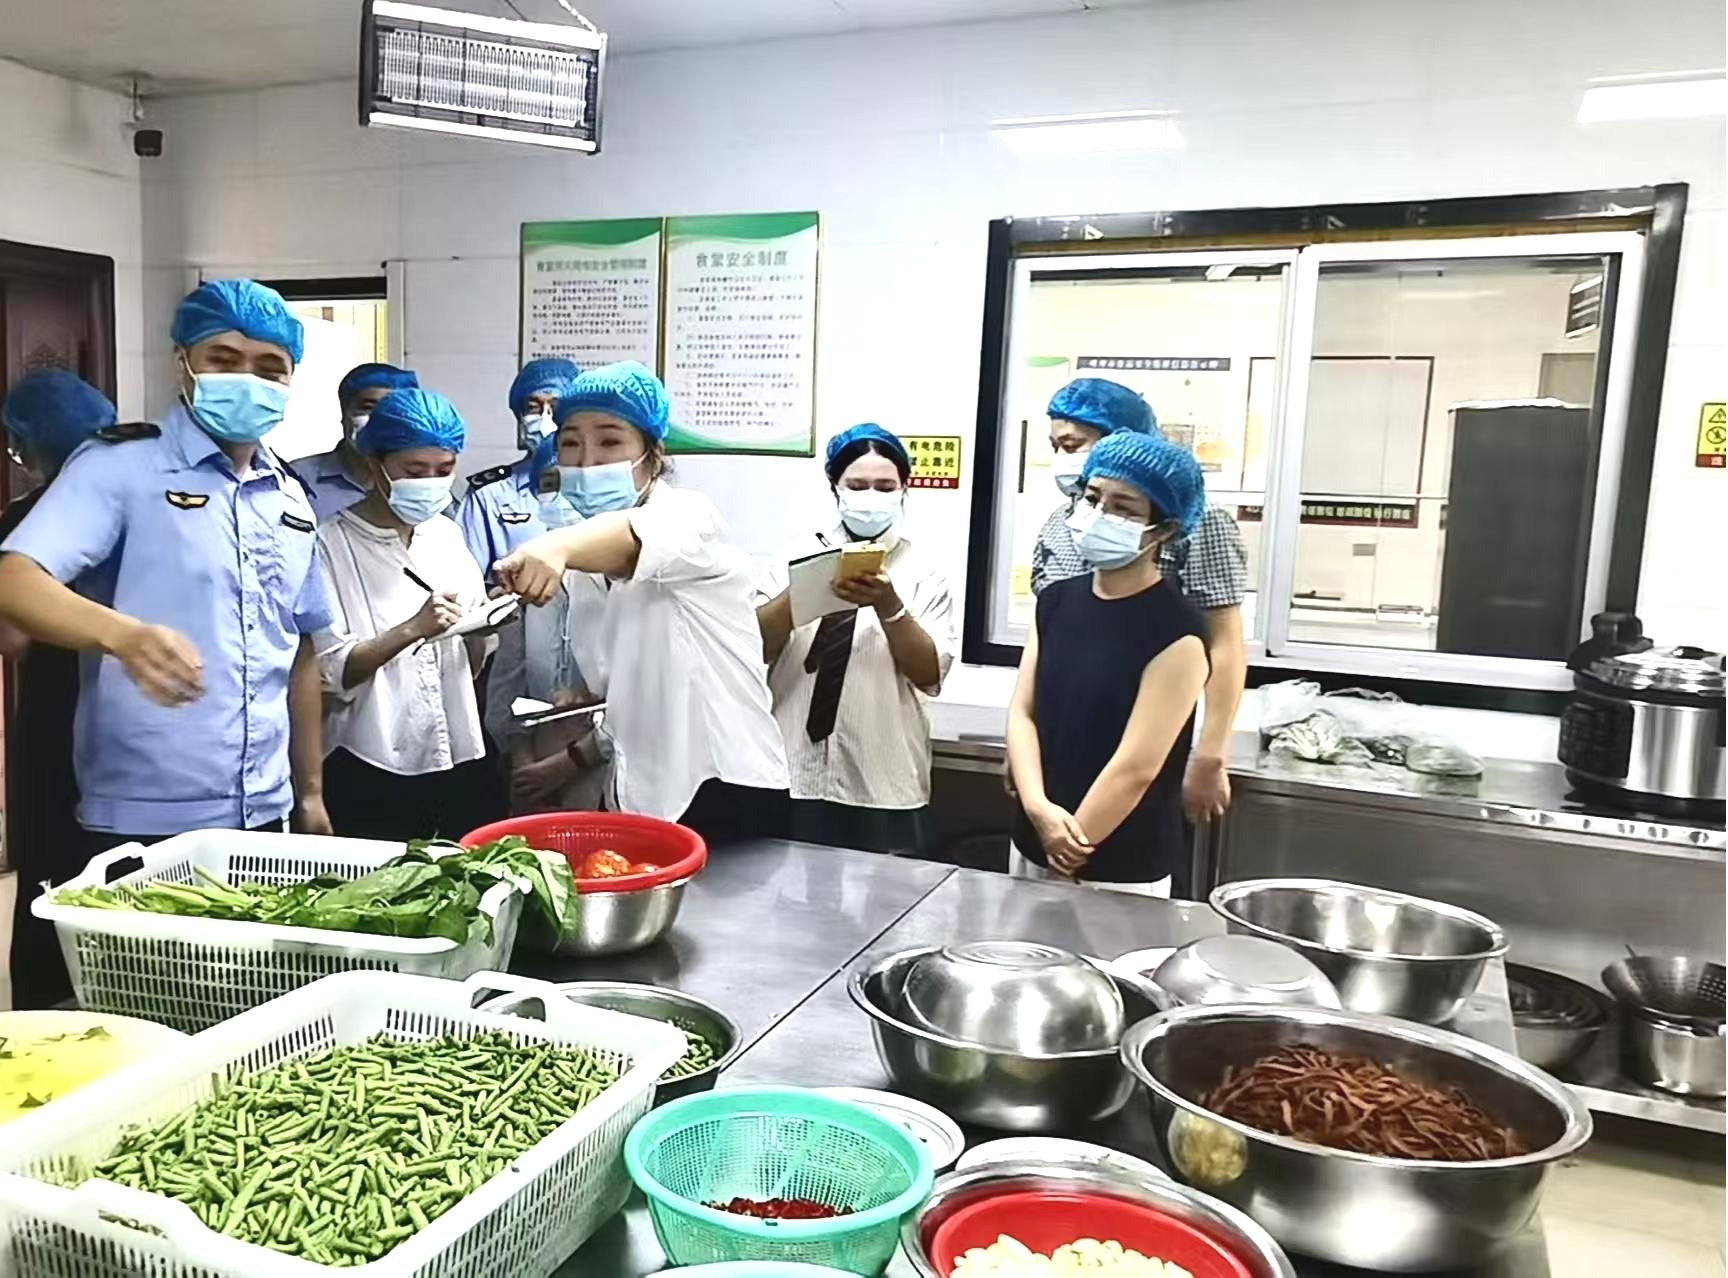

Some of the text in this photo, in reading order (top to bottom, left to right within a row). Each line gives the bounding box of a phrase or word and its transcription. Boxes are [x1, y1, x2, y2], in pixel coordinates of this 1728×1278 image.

[696, 250, 788, 268] 食堂安全制度
[909, 440, 955, 452] 有电危险
